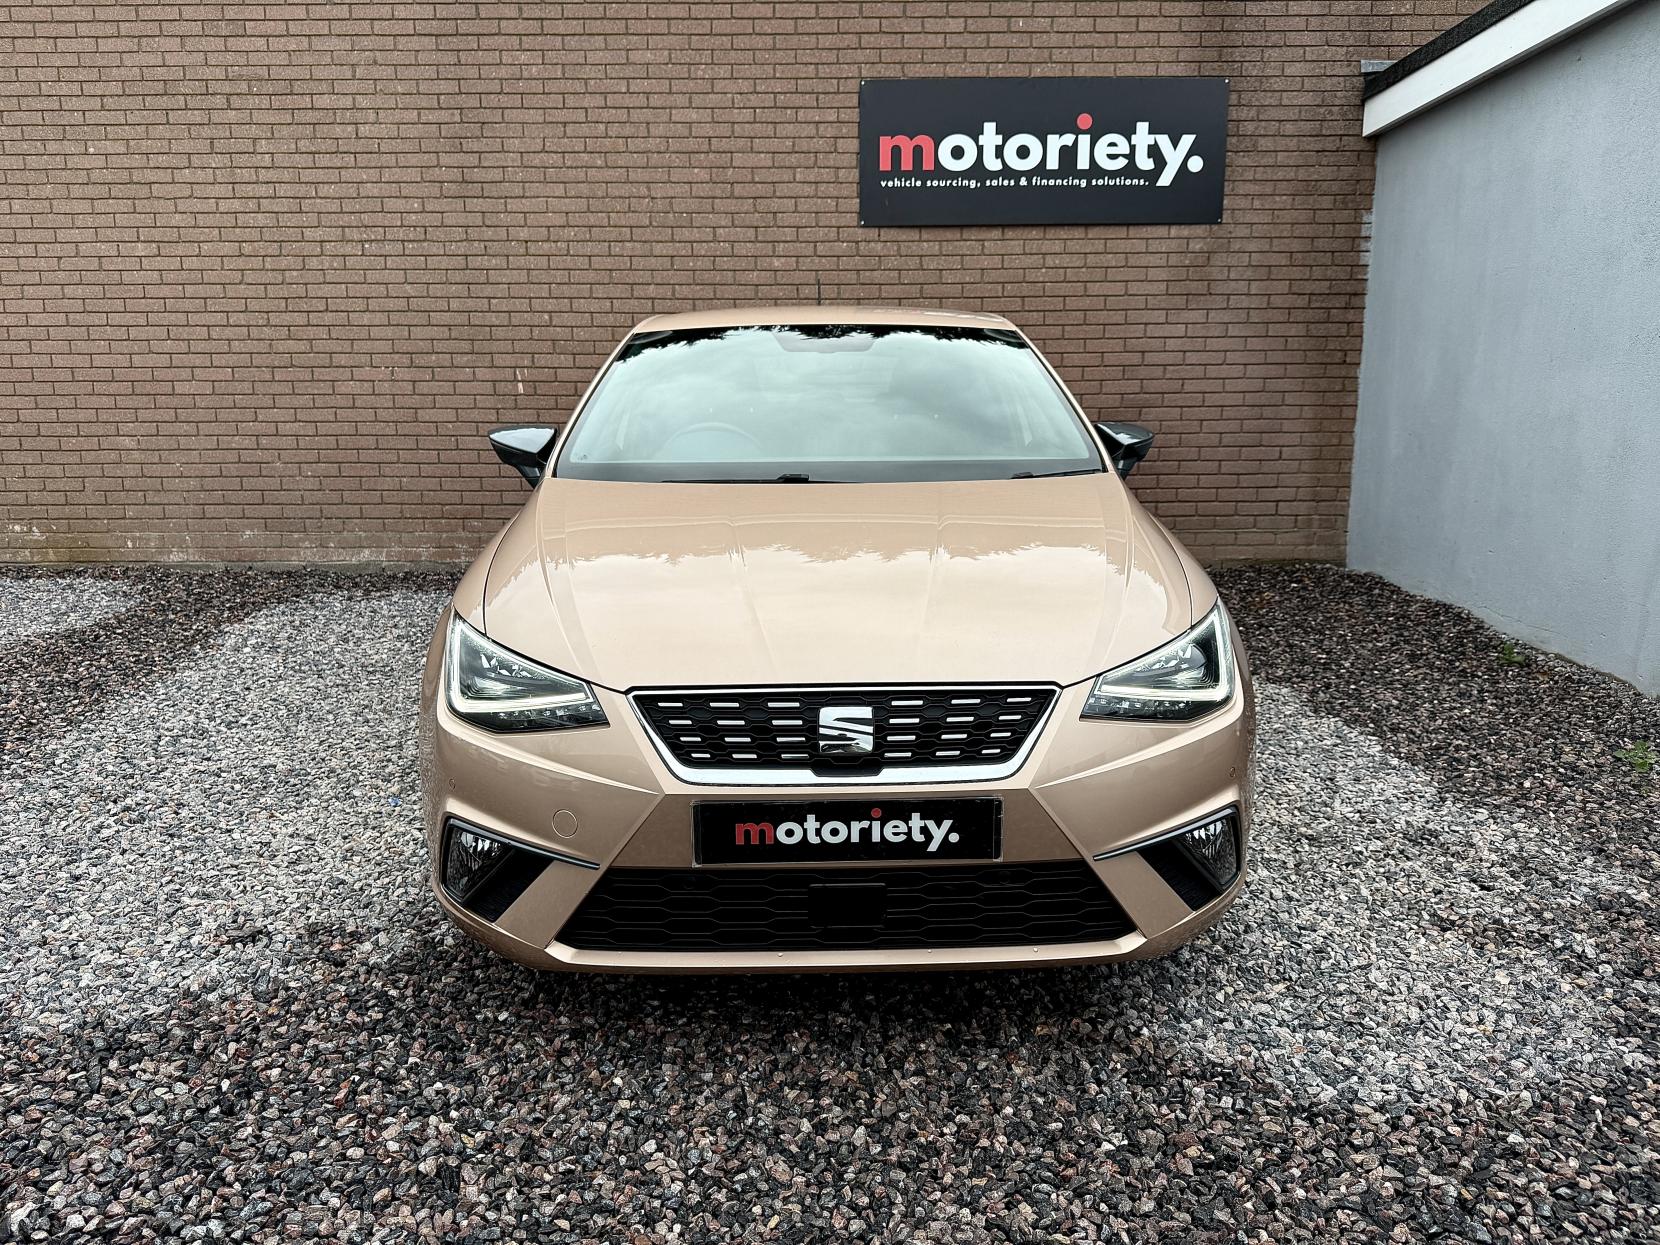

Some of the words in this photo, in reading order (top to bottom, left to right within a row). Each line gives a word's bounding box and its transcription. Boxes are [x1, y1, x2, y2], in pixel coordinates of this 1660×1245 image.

[879, 113, 1204, 187] motoriety.
[880, 177, 922, 188] vehicle
[926, 176, 981, 189] sourcing,
[985, 177, 1015, 187] sales
[1019, 177, 1027, 187] &
[1032, 175, 1087, 188] financing
[1091, 176, 1149, 187] solutions.
[735, 808, 960, 852] motoriety.
